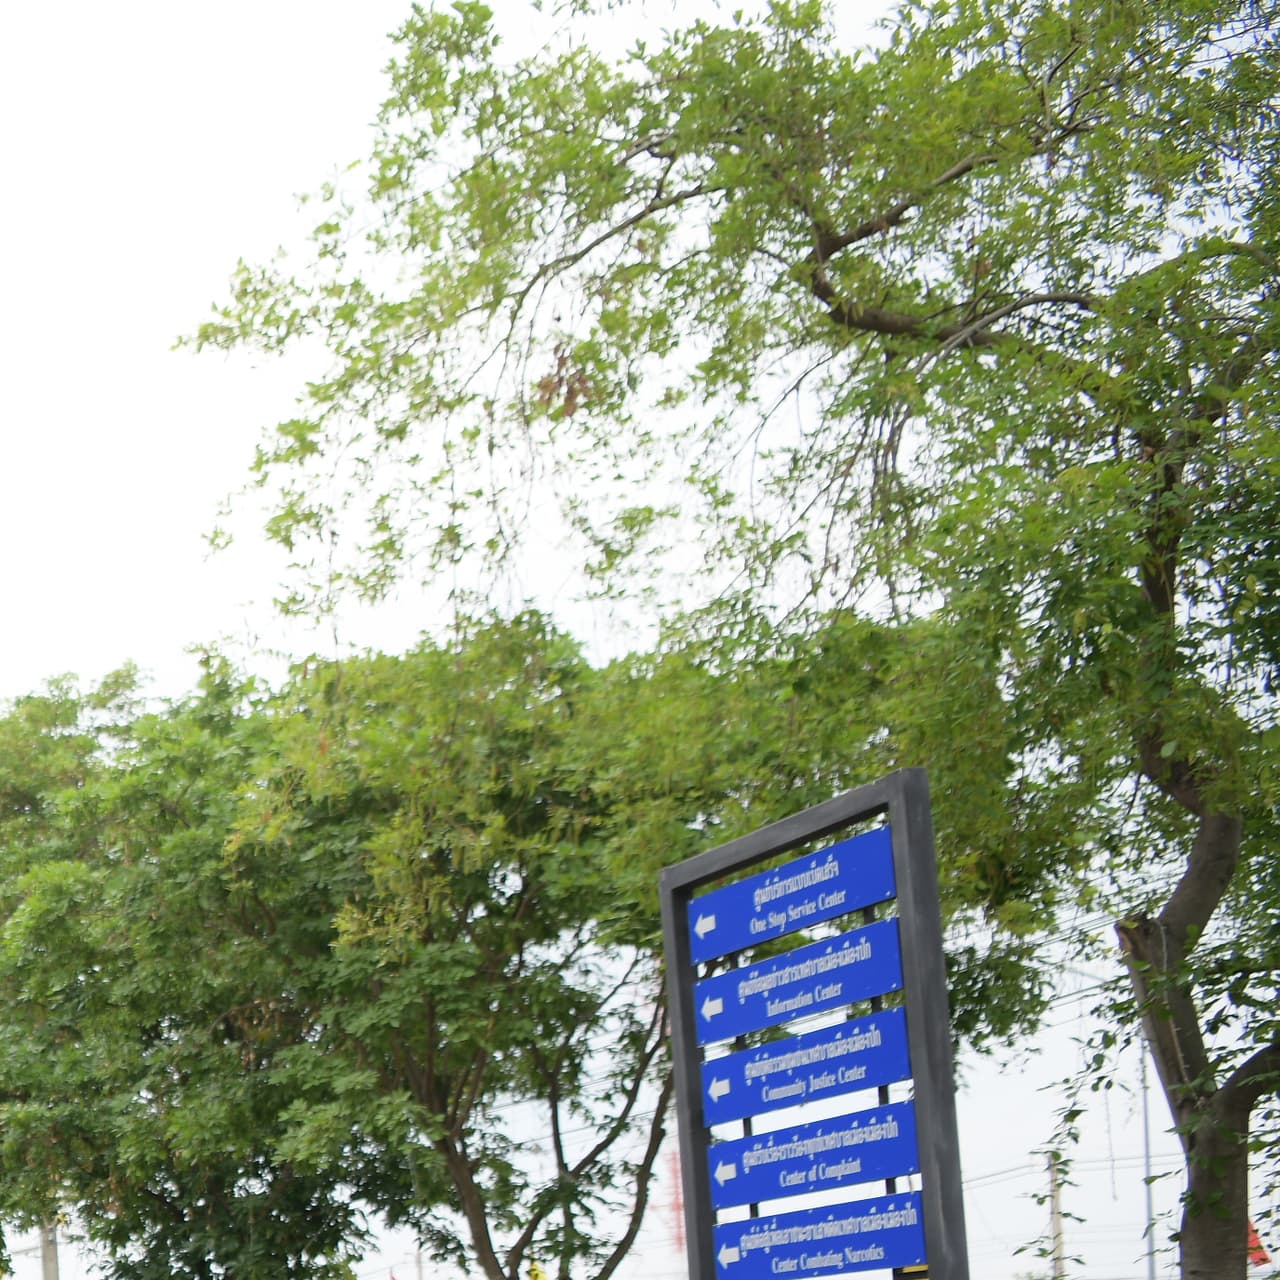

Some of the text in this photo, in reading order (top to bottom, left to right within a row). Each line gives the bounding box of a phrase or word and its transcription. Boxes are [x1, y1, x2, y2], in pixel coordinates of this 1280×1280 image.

[749, 889, 846, 935] One Stop Service Center
[766, 982, 843, 1017] Information Center
[761, 1065, 867, 1103] Community Justice Center
[779, 1156, 862, 1188] Center of Complaint
[771, 1243, 885, 1274] Center Combating Narcotics
